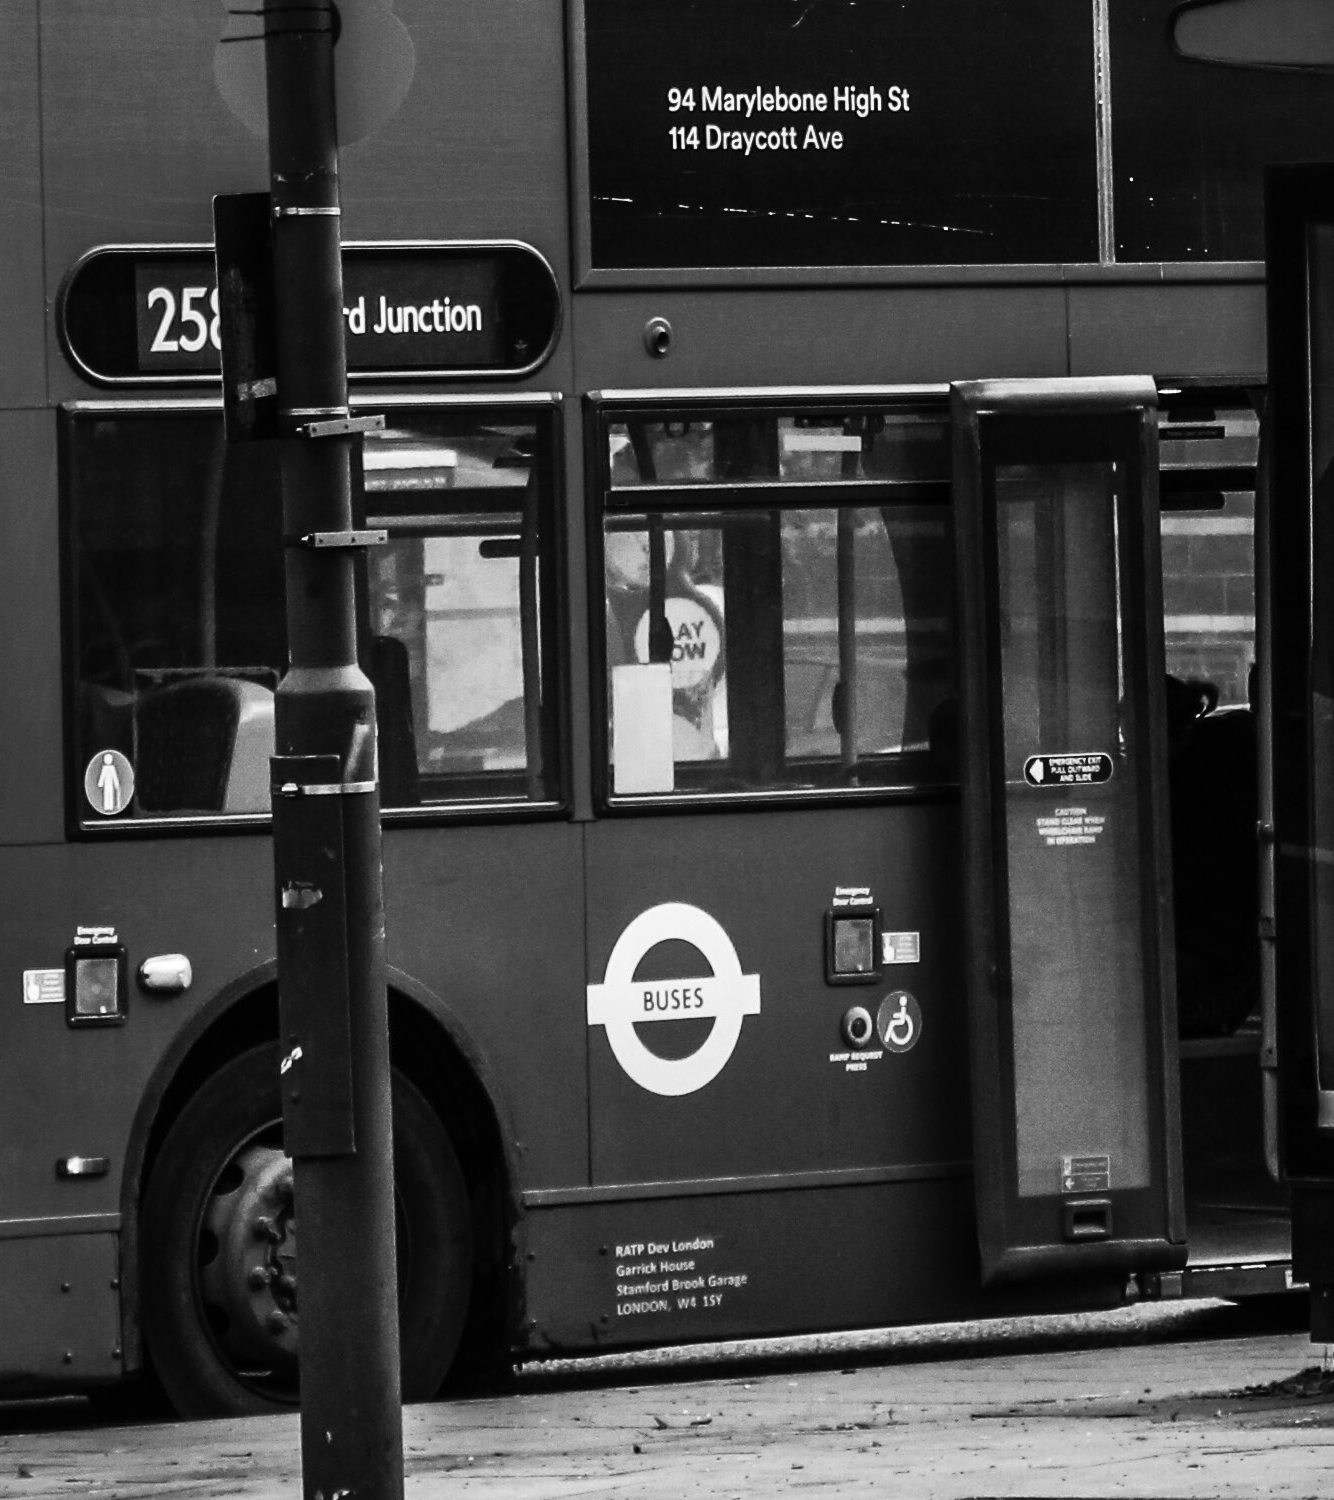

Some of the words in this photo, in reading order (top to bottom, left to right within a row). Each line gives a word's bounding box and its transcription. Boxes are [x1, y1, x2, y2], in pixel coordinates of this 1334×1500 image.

[667, 87, 696, 112] 94
[701, 85, 828, 118] Marylebone
[833, 85, 882, 118] High
[887, 85, 910, 112] St
[668, 125, 701, 150] 114
[705, 124, 798, 156] Draycott
[802, 124, 844, 150] Ave
[373, 295, 482, 334] Junction
[1048, 757, 1087, 767] EMERGENCY
[1087, 756, 1102, 765] EXIT
[1050, 766, 1067, 774] PULL
[1067, 764, 1101, 773] OUTWARD
[1059, 774, 1074, 782] AND
[1075, 773, 1092, 781] SLIDE
[1054, 807, 1087, 816] CAUTION
[835, 886, 871, 897] Emergency
[832, 898, 850, 906] Door
[849, 896, 874, 905] Control
[643, 987, 704, 1012] BUSES
[829, 1052, 850, 1062] RAMP
[851, 1051, 884, 1062] REQUEST
[845, 1062, 868, 1072] PRESS
[615, 1244, 645, 1257] RATP
[647, 1243, 670, 1255] Dev
[672, 1237, 714, 1253] London
[616, 1262, 657, 1277] Garrick
[660, 1260, 696, 1273] House
[617, 1280, 669, 1297] Stamford
[671, 1276, 705, 1291] Brook
[708, 1274, 748, 1288] Garage
[617, 1299, 672, 1316] LONDON,
[677, 1296, 697, 1310] W4
[703, 1293, 723, 1307] 1SY
